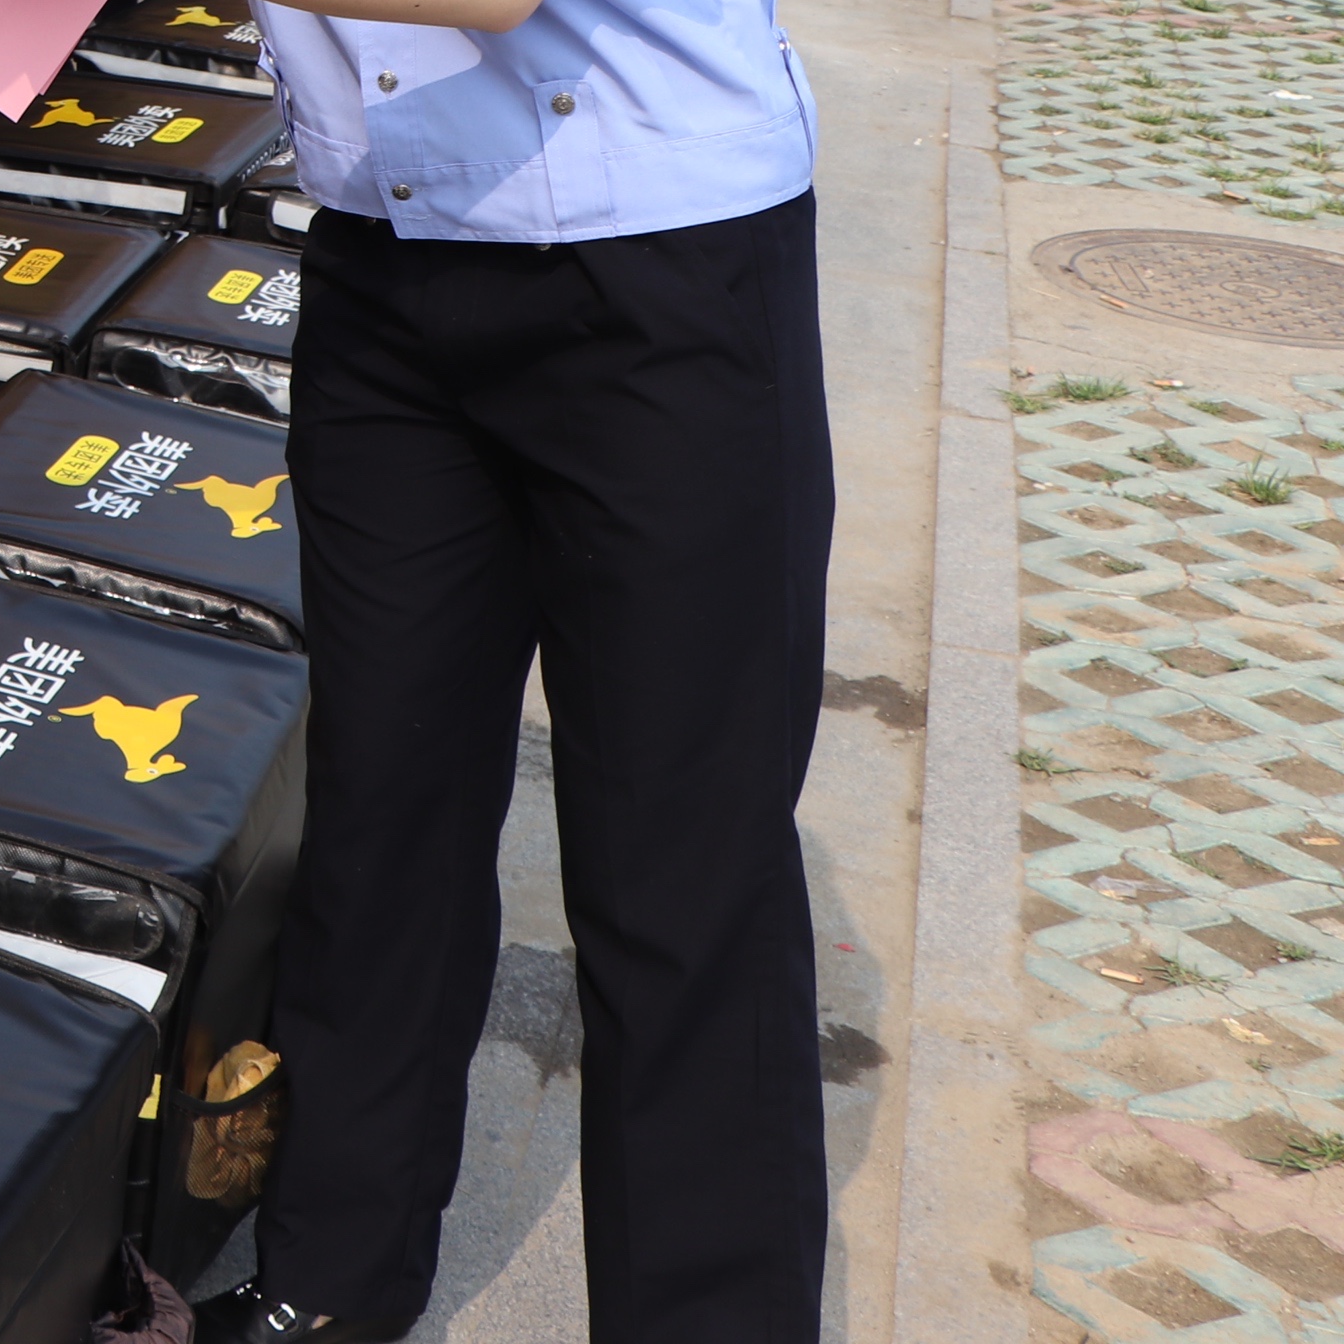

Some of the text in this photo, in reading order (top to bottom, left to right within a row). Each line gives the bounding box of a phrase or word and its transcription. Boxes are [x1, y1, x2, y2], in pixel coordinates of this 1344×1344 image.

[97, 105, 182, 147] 美团外卖
[52, 440, 112, 482] 美团专送
[74, 430, 193, 522] 美团外卖
